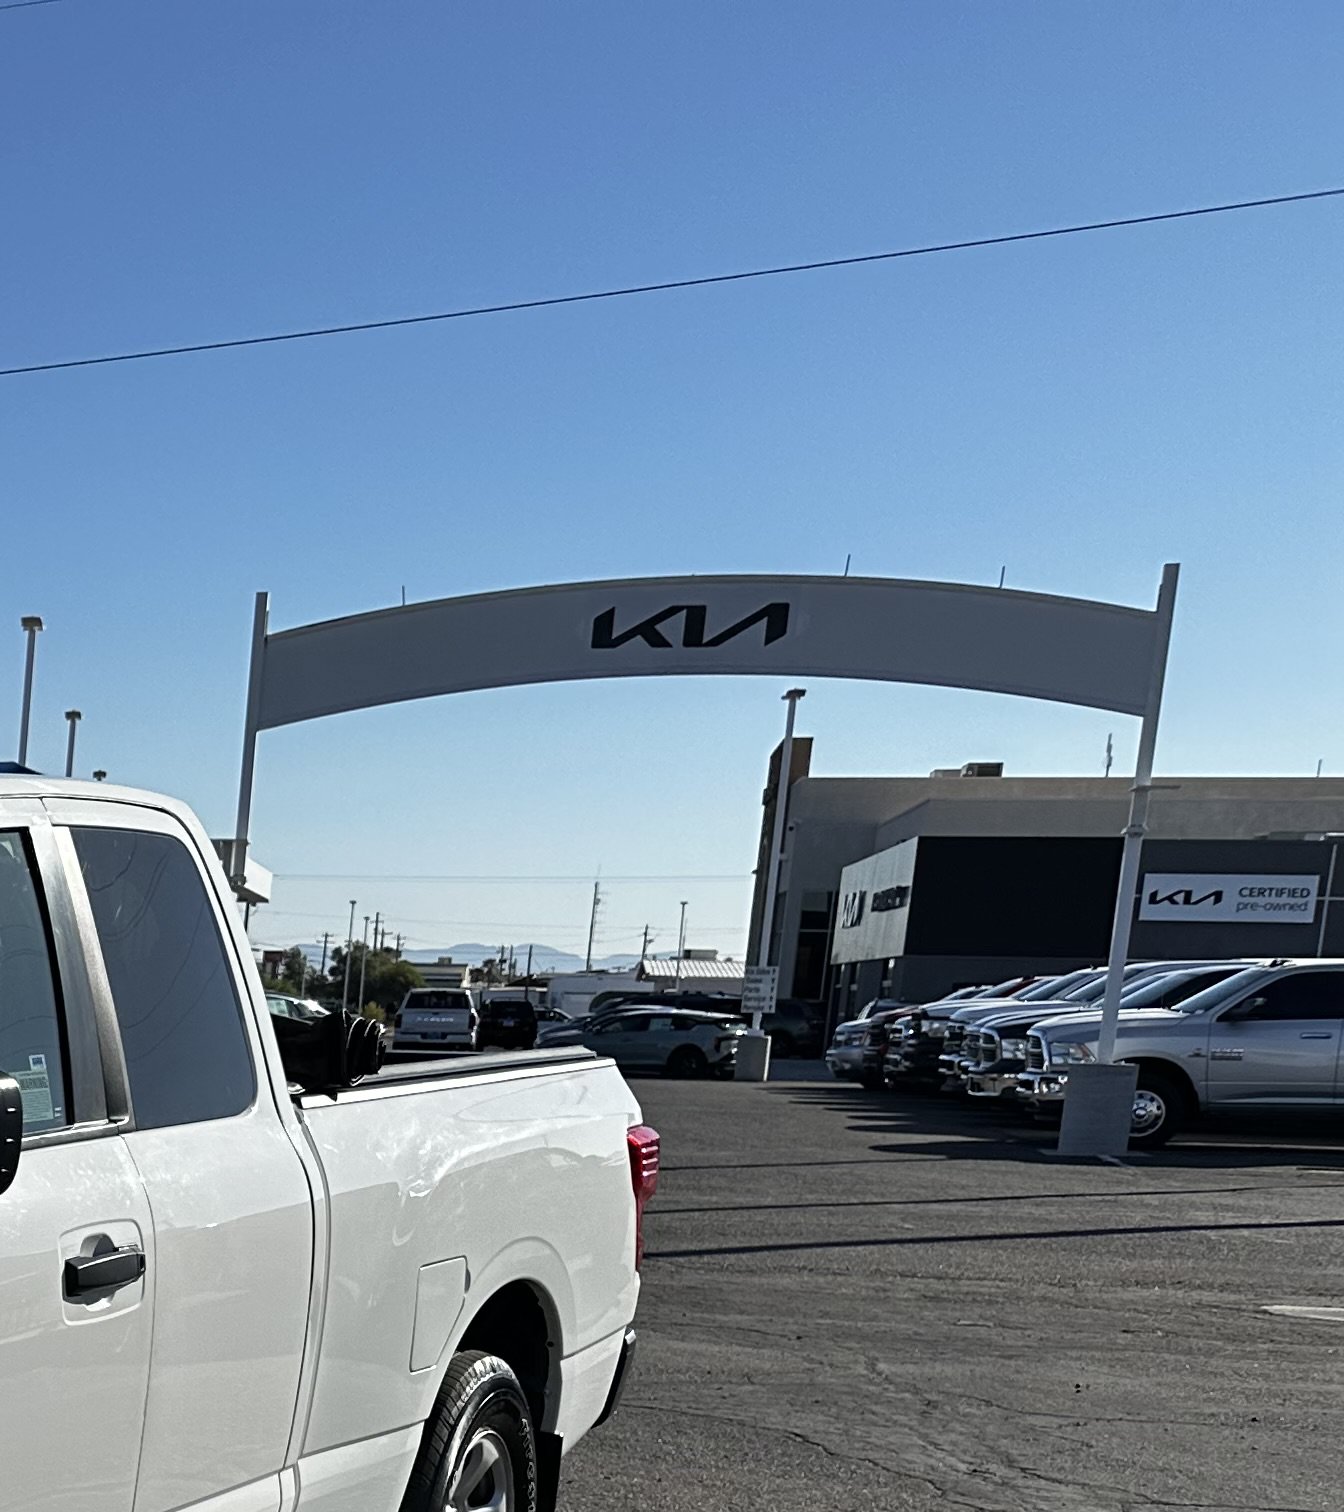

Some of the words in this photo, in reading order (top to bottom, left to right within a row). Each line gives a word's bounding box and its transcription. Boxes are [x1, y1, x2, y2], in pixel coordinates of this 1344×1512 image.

[591, 603, 790, 649] KIA
[1149, 889, 1224, 906] KIA
[1238, 886, 1311, 899] CERTIFIED
[1235, 901, 1309, 913] pre-owned
